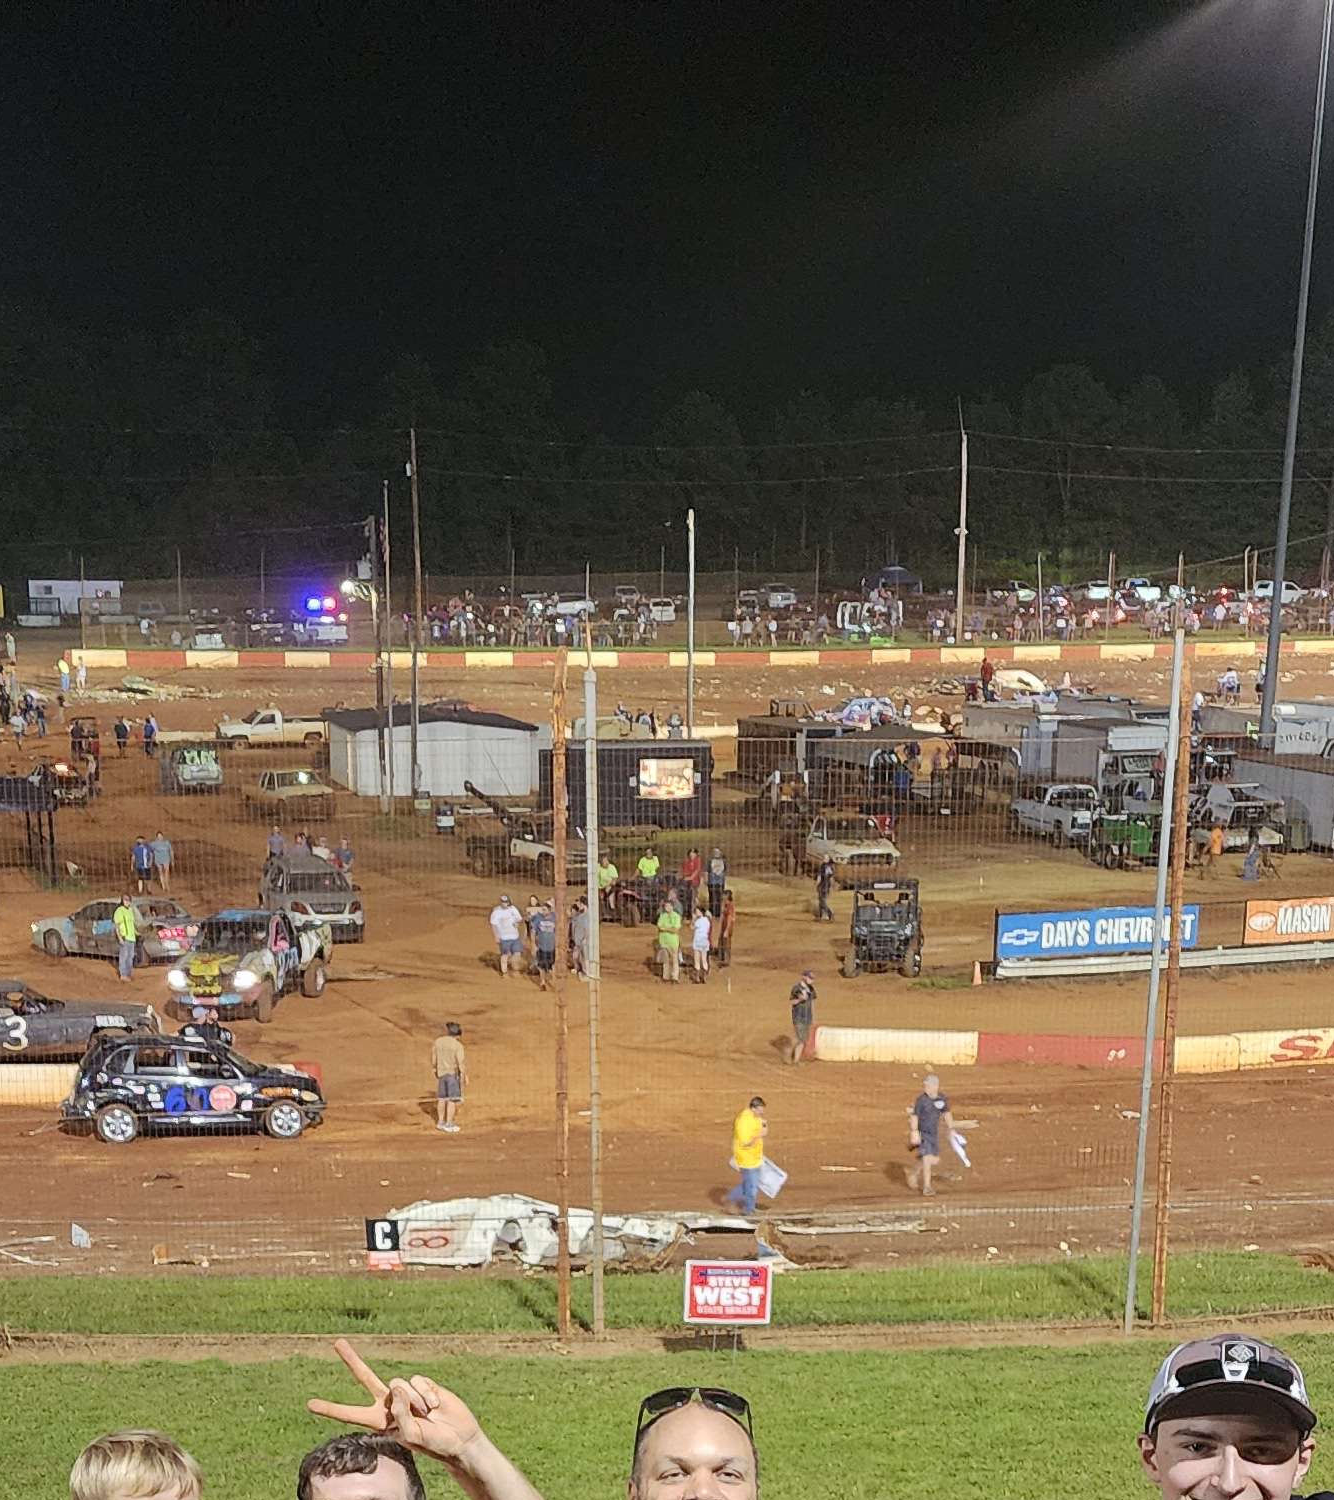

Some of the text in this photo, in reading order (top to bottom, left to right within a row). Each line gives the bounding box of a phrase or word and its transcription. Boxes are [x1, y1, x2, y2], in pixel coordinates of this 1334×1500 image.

[1041, 918, 1091, 949] DAY'S
[1276, 904, 1331, 935] MASON
[2, 1015, 28, 1051] 3
[694, 1286, 765, 1307] WEST
